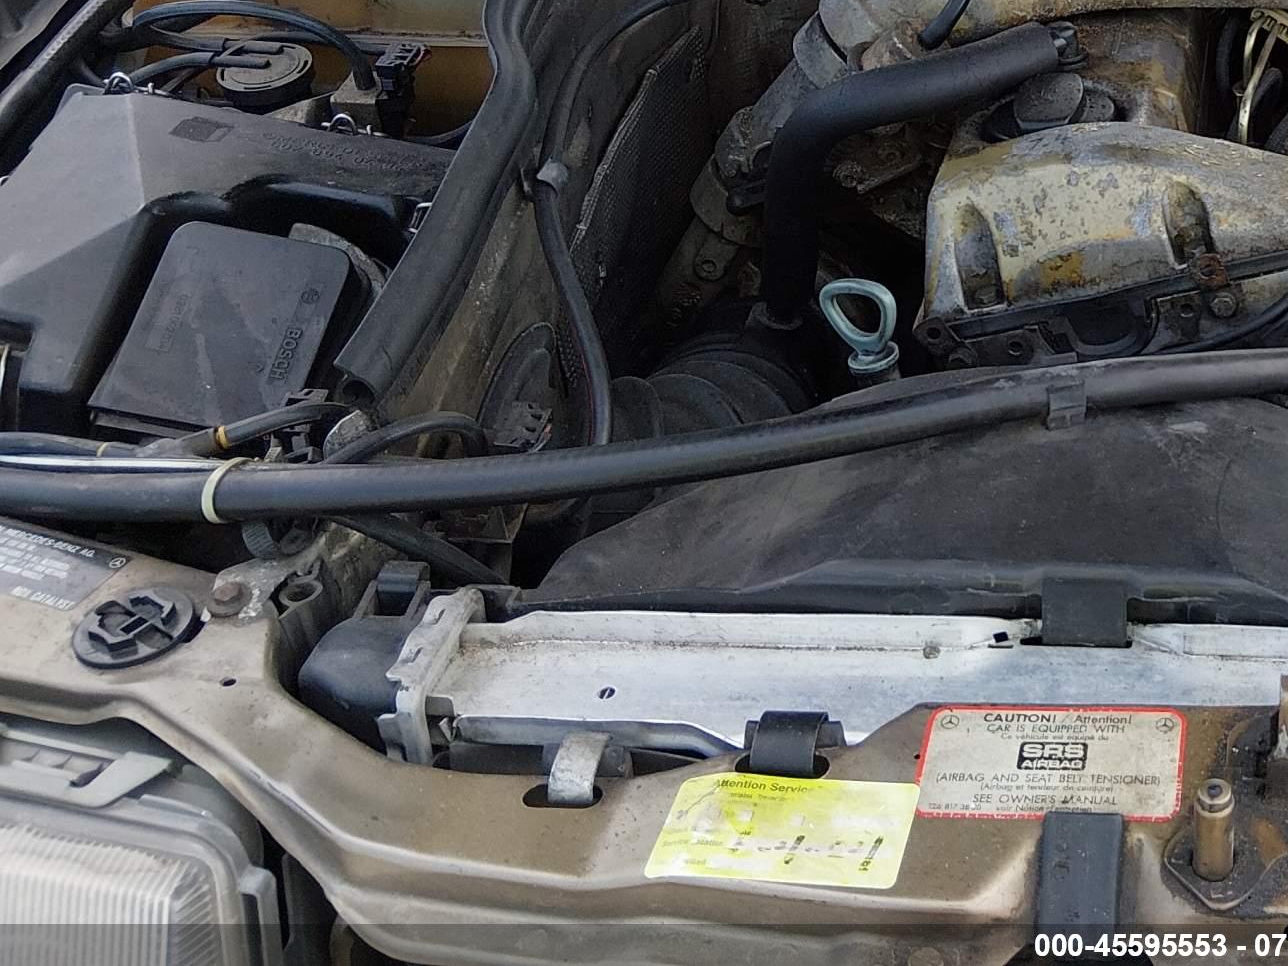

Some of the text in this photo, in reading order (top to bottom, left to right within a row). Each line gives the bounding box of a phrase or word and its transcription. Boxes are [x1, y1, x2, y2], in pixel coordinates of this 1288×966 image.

[270, 328, 303, 379] BOSCH
[5, 528, 81, 553] MERCEDES-BENZ
[984, 713, 1056, 724] CAUTION!
[1074, 714, 1132, 724] Attention!
[987, 724, 1125, 733] CAR IS EQUIPPED WITH
[1022, 744, 1085, 759] SRS
[1021, 759, 1083, 769] AIRBAG
[718, 779, 767, 791] Attention
[936, 773, 1161, 786] (AIRBAG AND SEAT BELT TENSIONER)
[973, 794, 1118, 805] SEE OWNER'S MANUAL
